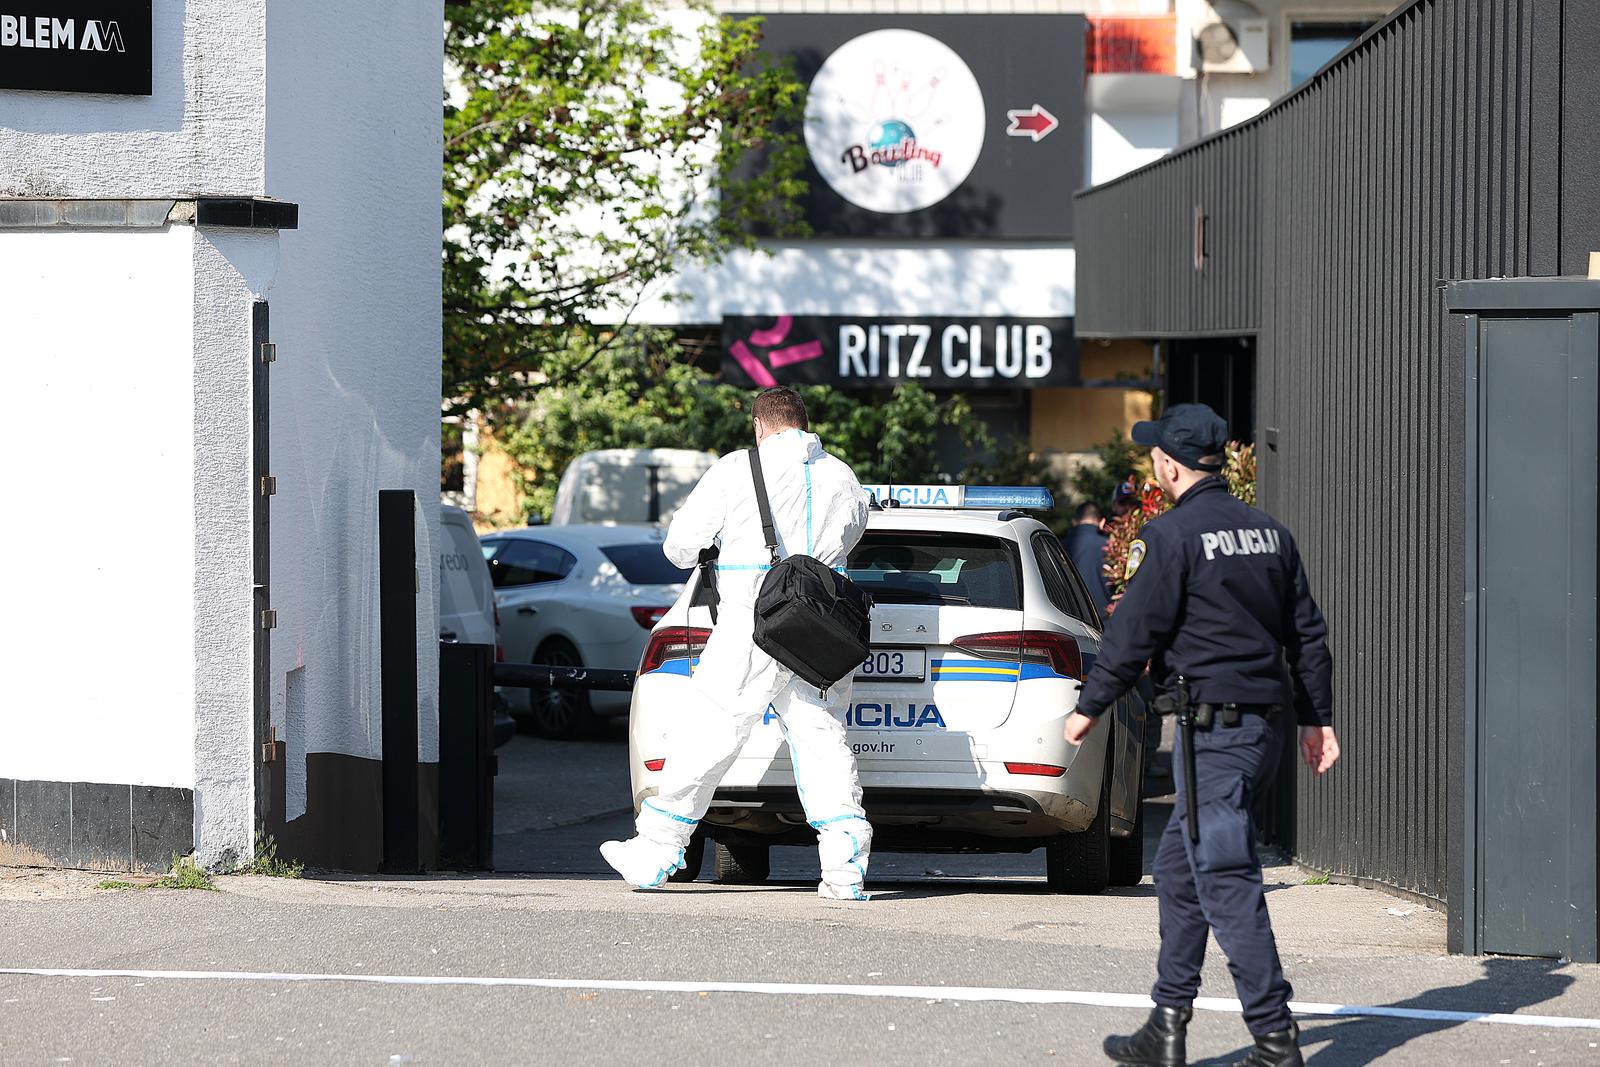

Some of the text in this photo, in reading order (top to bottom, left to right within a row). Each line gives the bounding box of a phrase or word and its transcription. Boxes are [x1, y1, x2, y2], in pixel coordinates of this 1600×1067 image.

[1, 14, 75, 50] BLEM
[841, 140, 942, 174] Bowling
[838, 324, 1053, 378] RITZ CLUB
